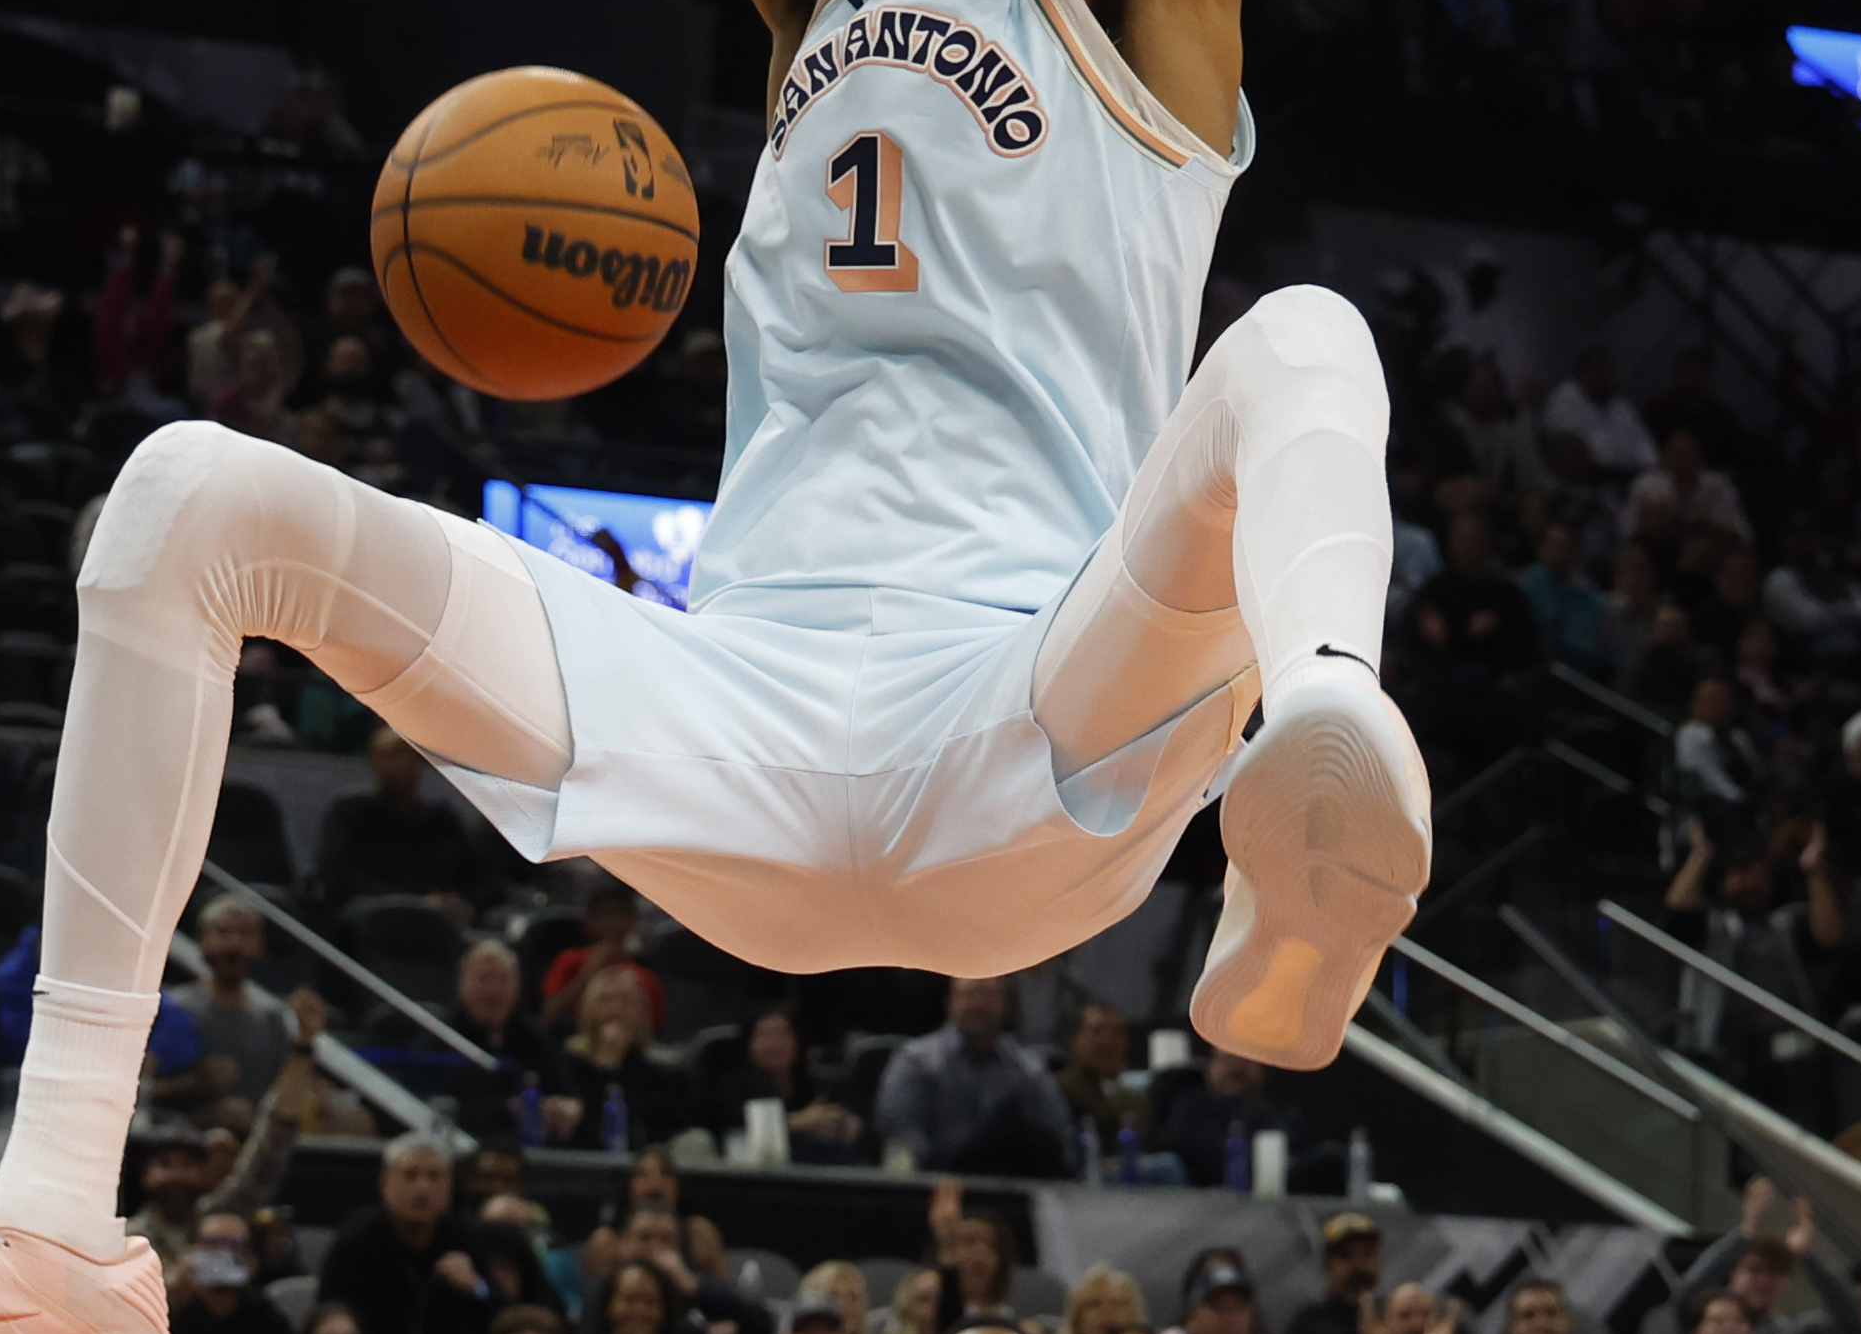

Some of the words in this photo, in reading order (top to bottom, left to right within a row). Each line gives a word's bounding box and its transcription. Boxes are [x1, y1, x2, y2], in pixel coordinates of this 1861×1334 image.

[770, 35, 847, 161] SAN
[843, 5, 1049, 158] ANTONIO
[522, 223, 689, 312] Wilson
[824, 130, 919, 292] 1
